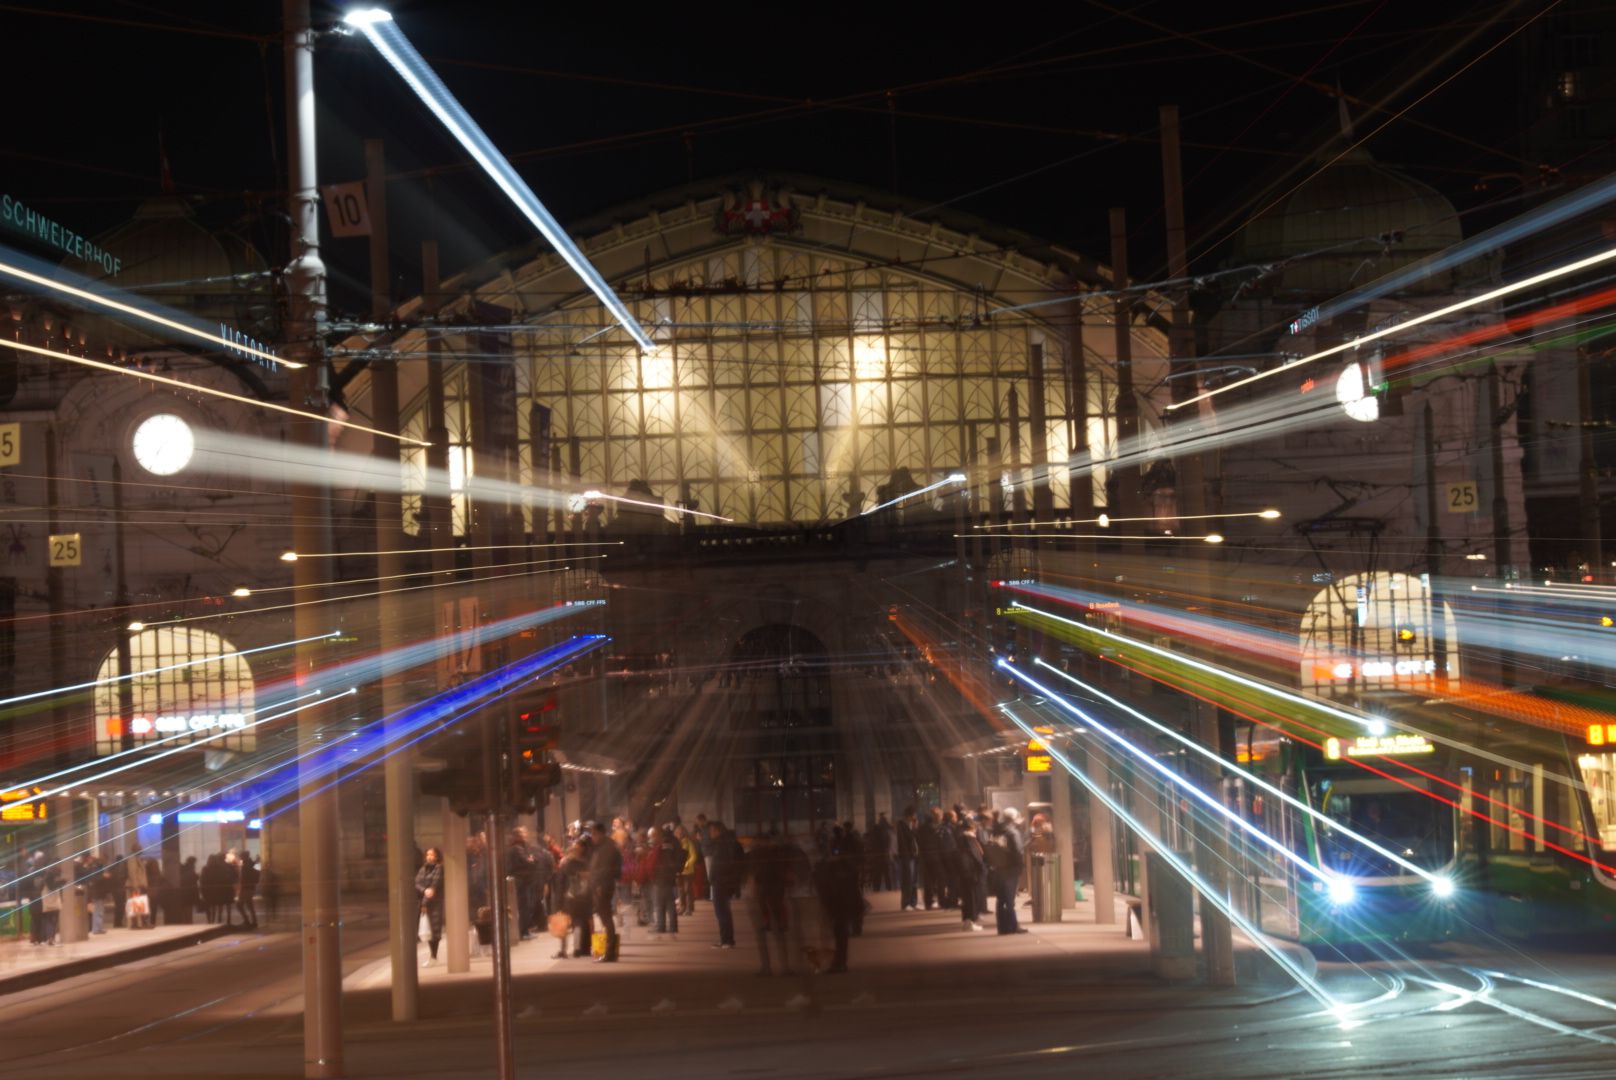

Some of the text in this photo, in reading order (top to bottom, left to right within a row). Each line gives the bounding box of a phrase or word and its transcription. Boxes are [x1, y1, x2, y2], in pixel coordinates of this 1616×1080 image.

[334, 194, 361, 227] 10
[3, 194, 121, 278] SCHWEIZERHOF
[220, 322, 277, 373] VICTORIA
[1450, 486, 1474, 507] 25
[54, 541, 77, 560] 25
